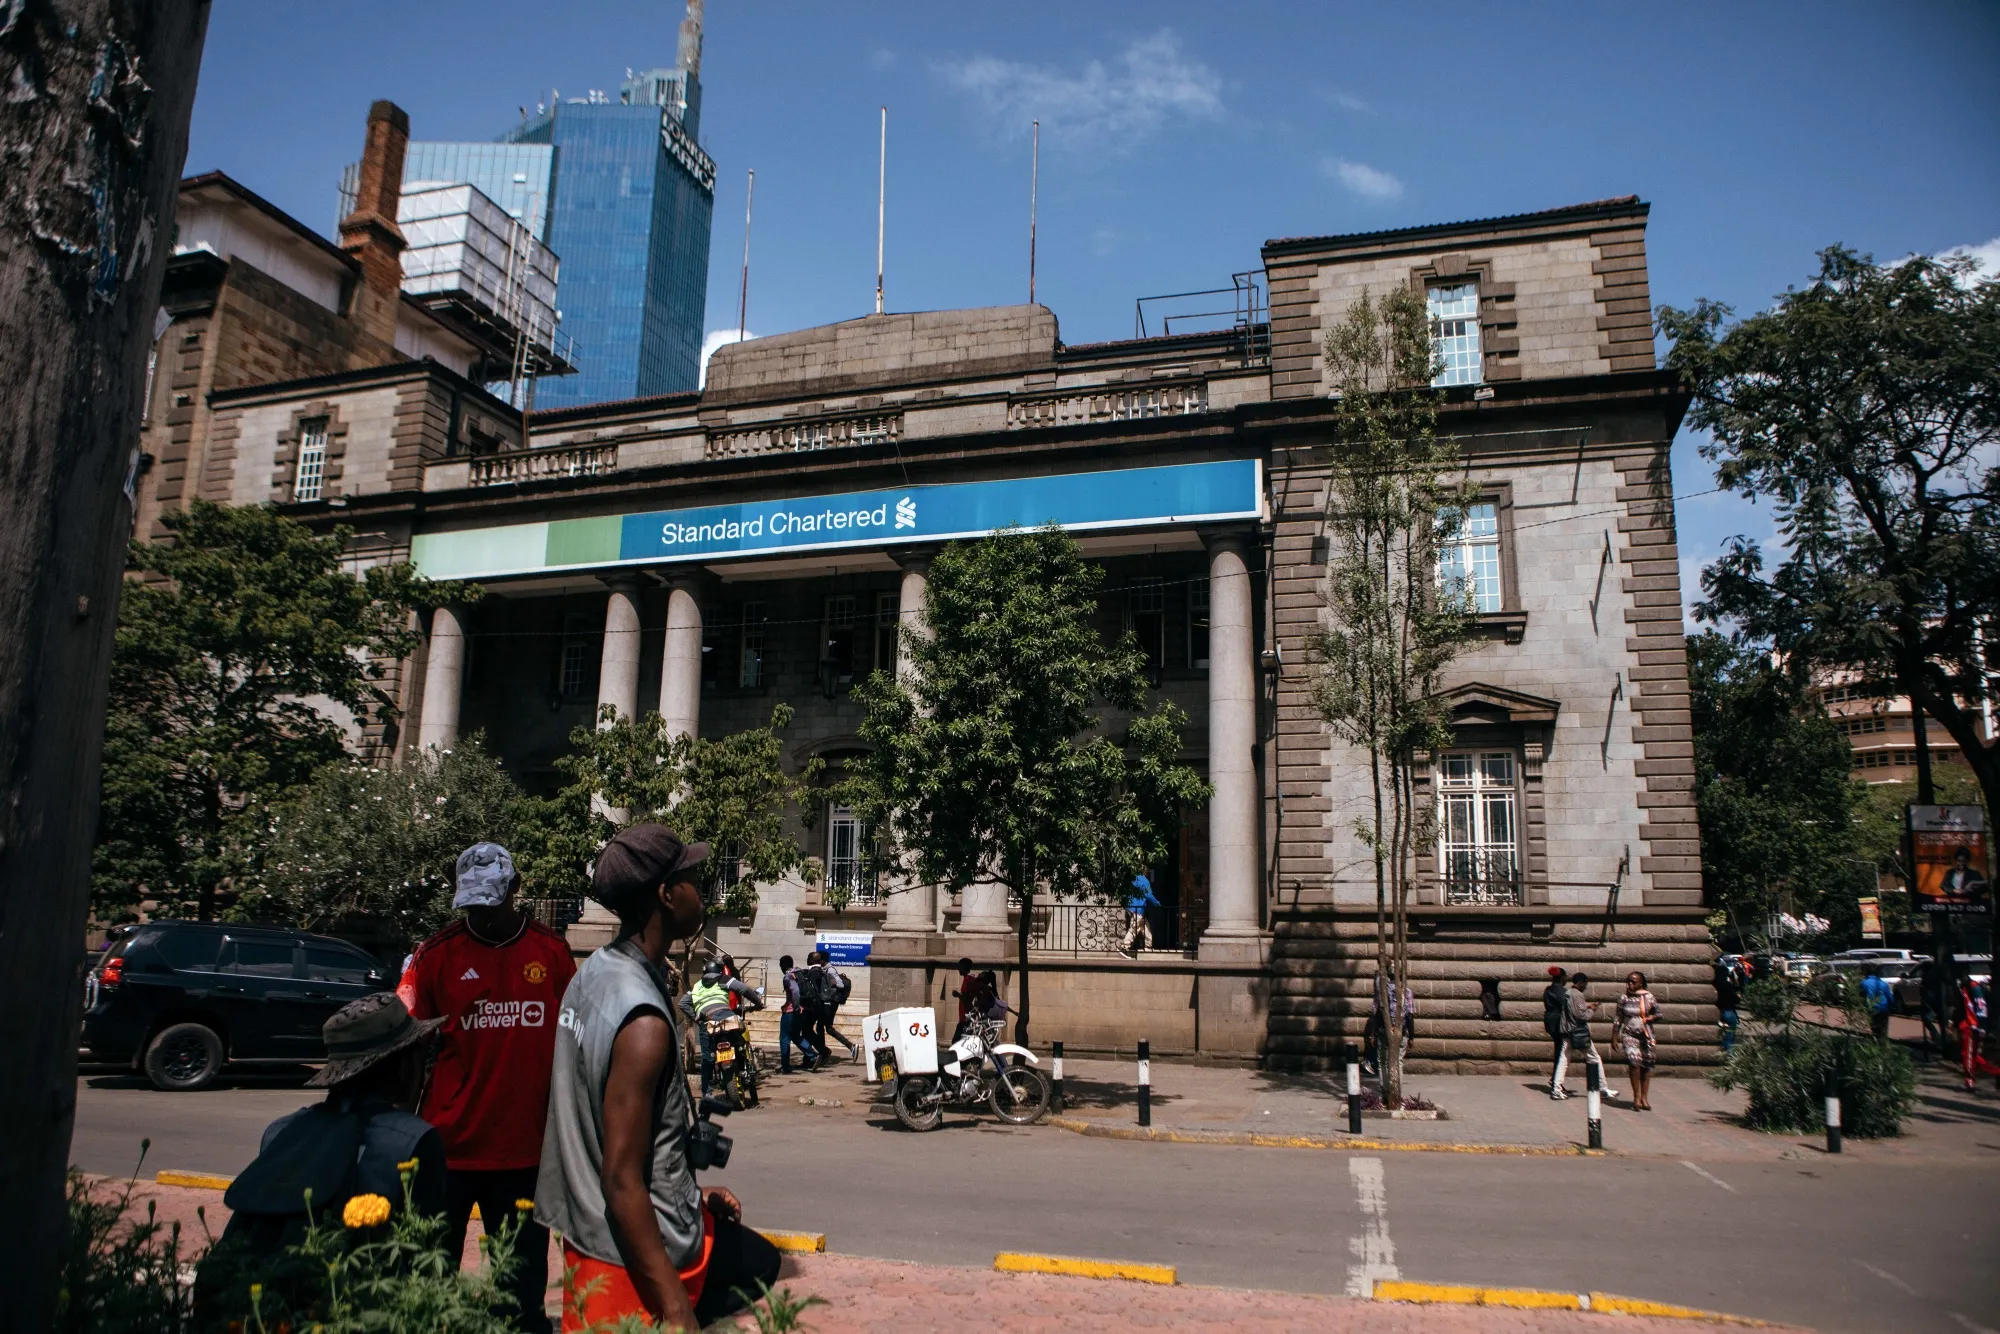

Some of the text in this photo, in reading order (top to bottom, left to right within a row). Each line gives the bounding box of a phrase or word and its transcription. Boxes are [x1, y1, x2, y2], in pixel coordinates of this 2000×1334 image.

[661, 503, 886, 545] Standard Chartered
[474, 999, 520, 1015] Team
[460, 1013, 520, 1030] Viewer
